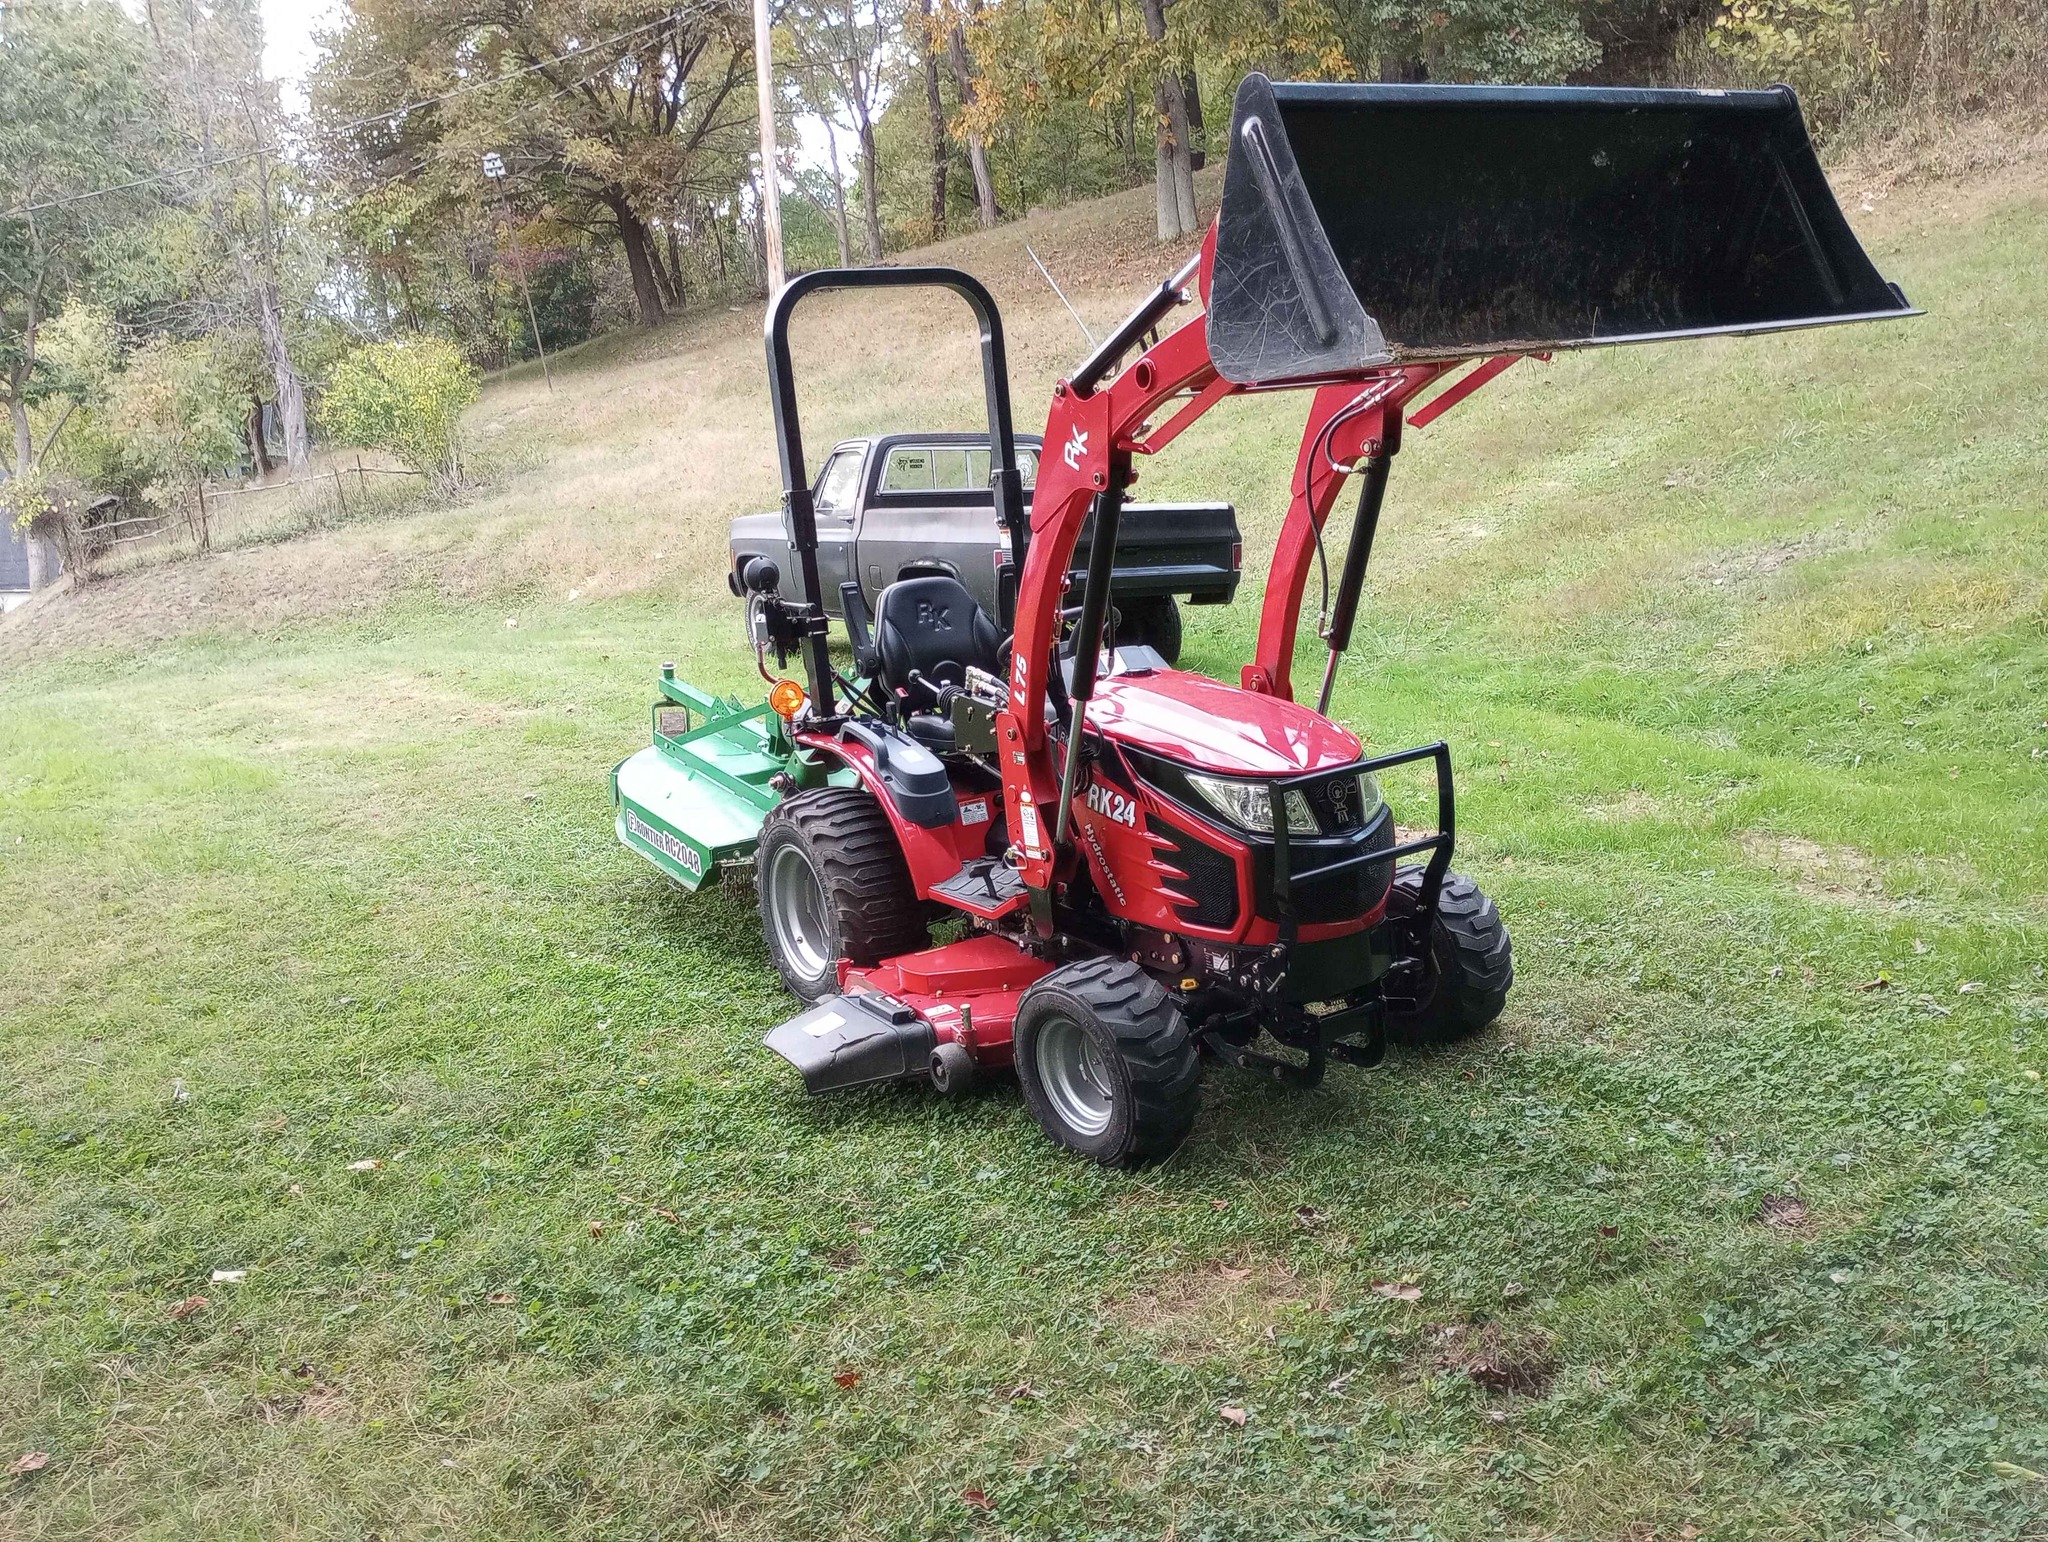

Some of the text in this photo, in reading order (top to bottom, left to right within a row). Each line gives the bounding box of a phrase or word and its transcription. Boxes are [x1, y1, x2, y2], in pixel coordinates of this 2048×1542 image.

[917, 602, 952, 632] RK
[1014, 652, 1027, 706] L75
[1086, 783, 1136, 829] RK24
[664, 833, 701, 874] RC2048
[1084, 823, 1127, 907] Hydrostatic
